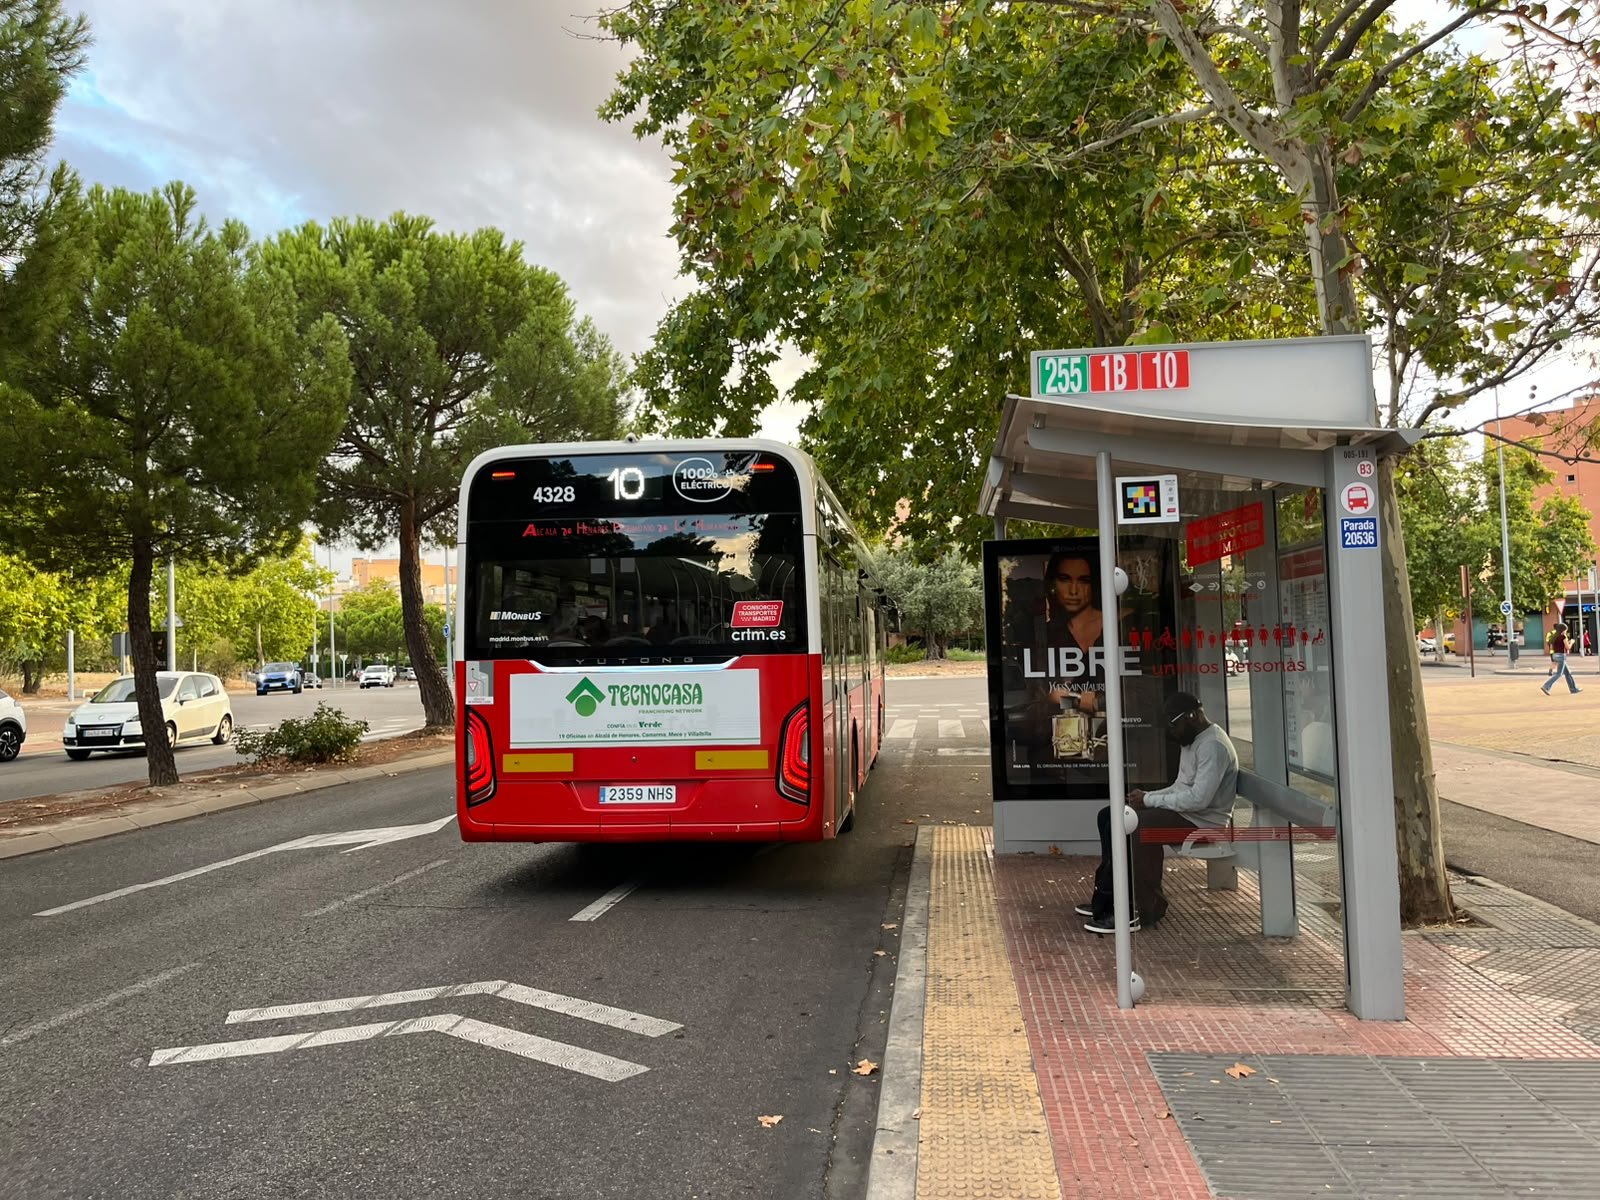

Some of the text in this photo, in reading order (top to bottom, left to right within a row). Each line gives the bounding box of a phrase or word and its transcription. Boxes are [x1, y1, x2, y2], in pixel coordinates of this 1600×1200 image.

[1045, 352, 1177, 394] 255 1B 10
[681, 468, 718, 480] 100%
[1359, 463, 1372, 475] B3
[607, 467, 645, 500] 10
[681, 479, 730, 490] ELÉCTRICO
[533, 486, 576, 503] 4328
[1343, 520, 1374, 531] Parada
[1344, 531, 1375, 546] 20536
[731, 628, 787, 641] crtm.es
[576, 657, 694, 665] YUTONG
[1023, 645, 1143, 678] LIBRE
[608, 683, 703, 707] TECNOCASA
[609, 787, 673, 801] 2359 NHS
